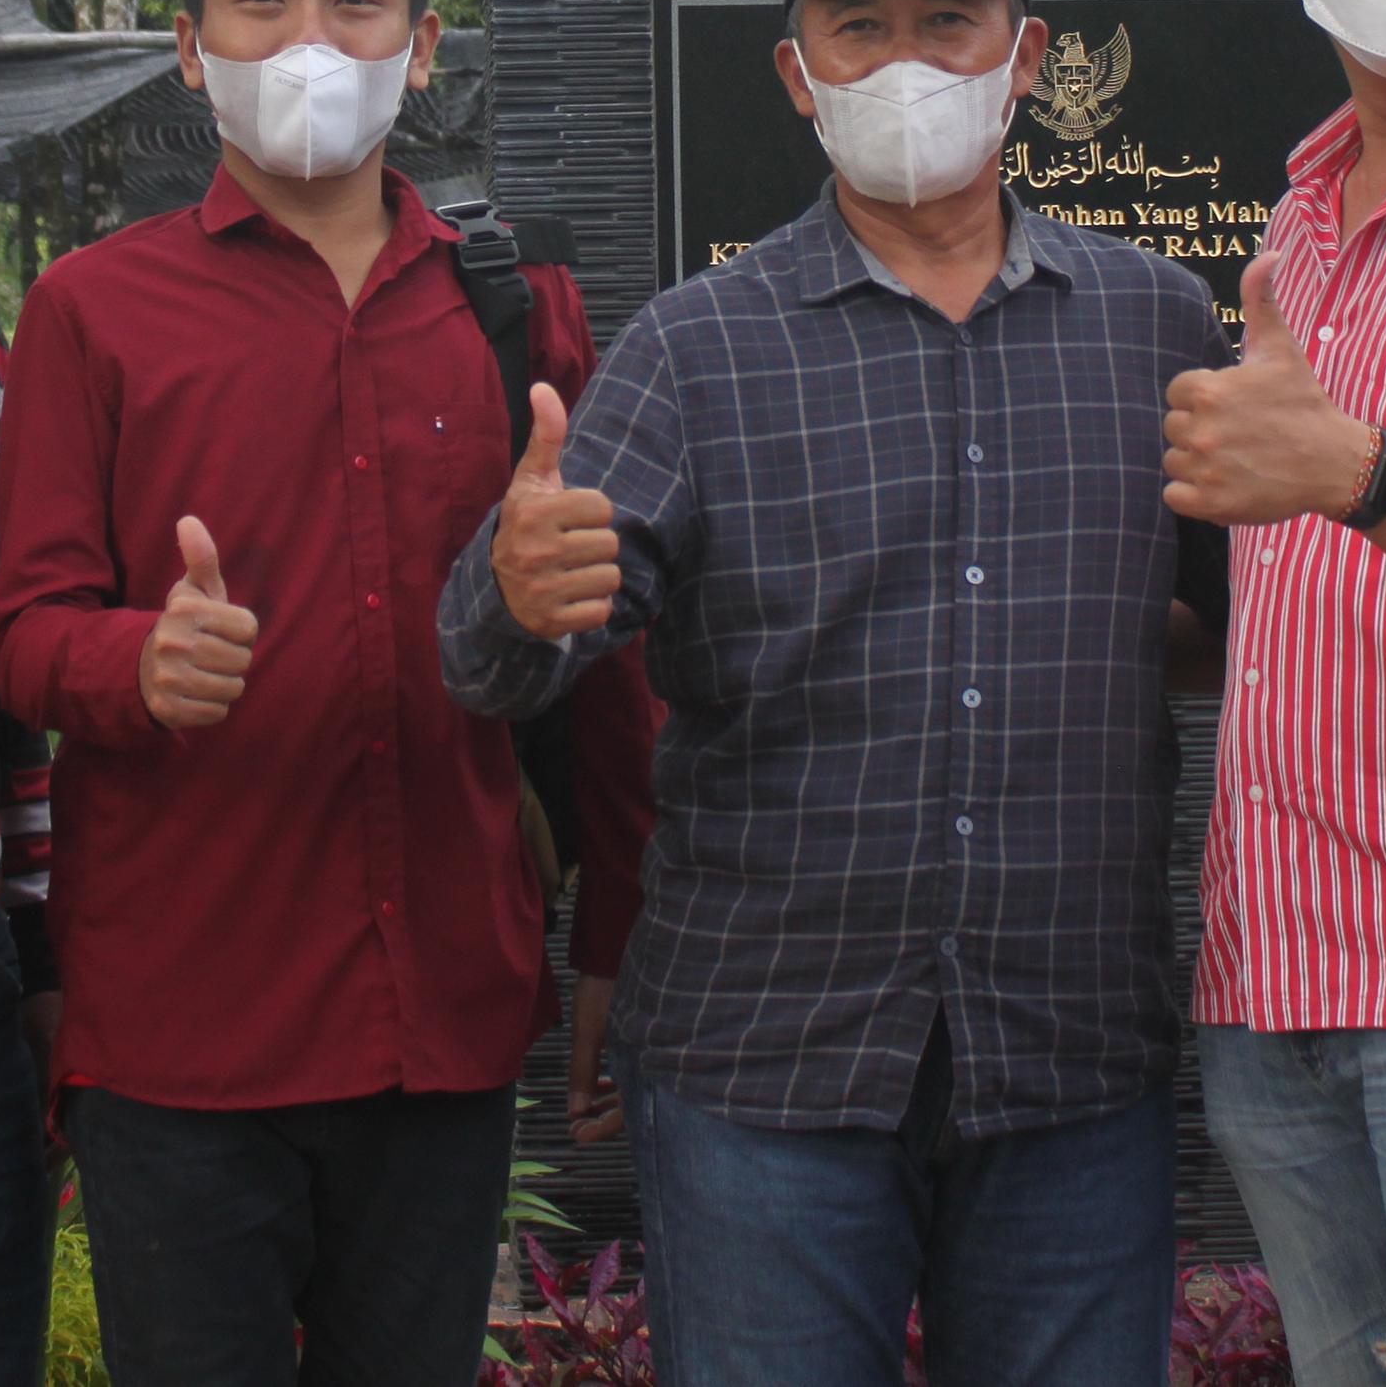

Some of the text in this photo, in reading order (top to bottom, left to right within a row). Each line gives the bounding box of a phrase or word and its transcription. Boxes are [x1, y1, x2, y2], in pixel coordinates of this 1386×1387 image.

[1039, 203, 1126, 226] Tuhan
[1131, 202, 1200, 231] Yang
[1163, 234, 1247, 258] RAJA
